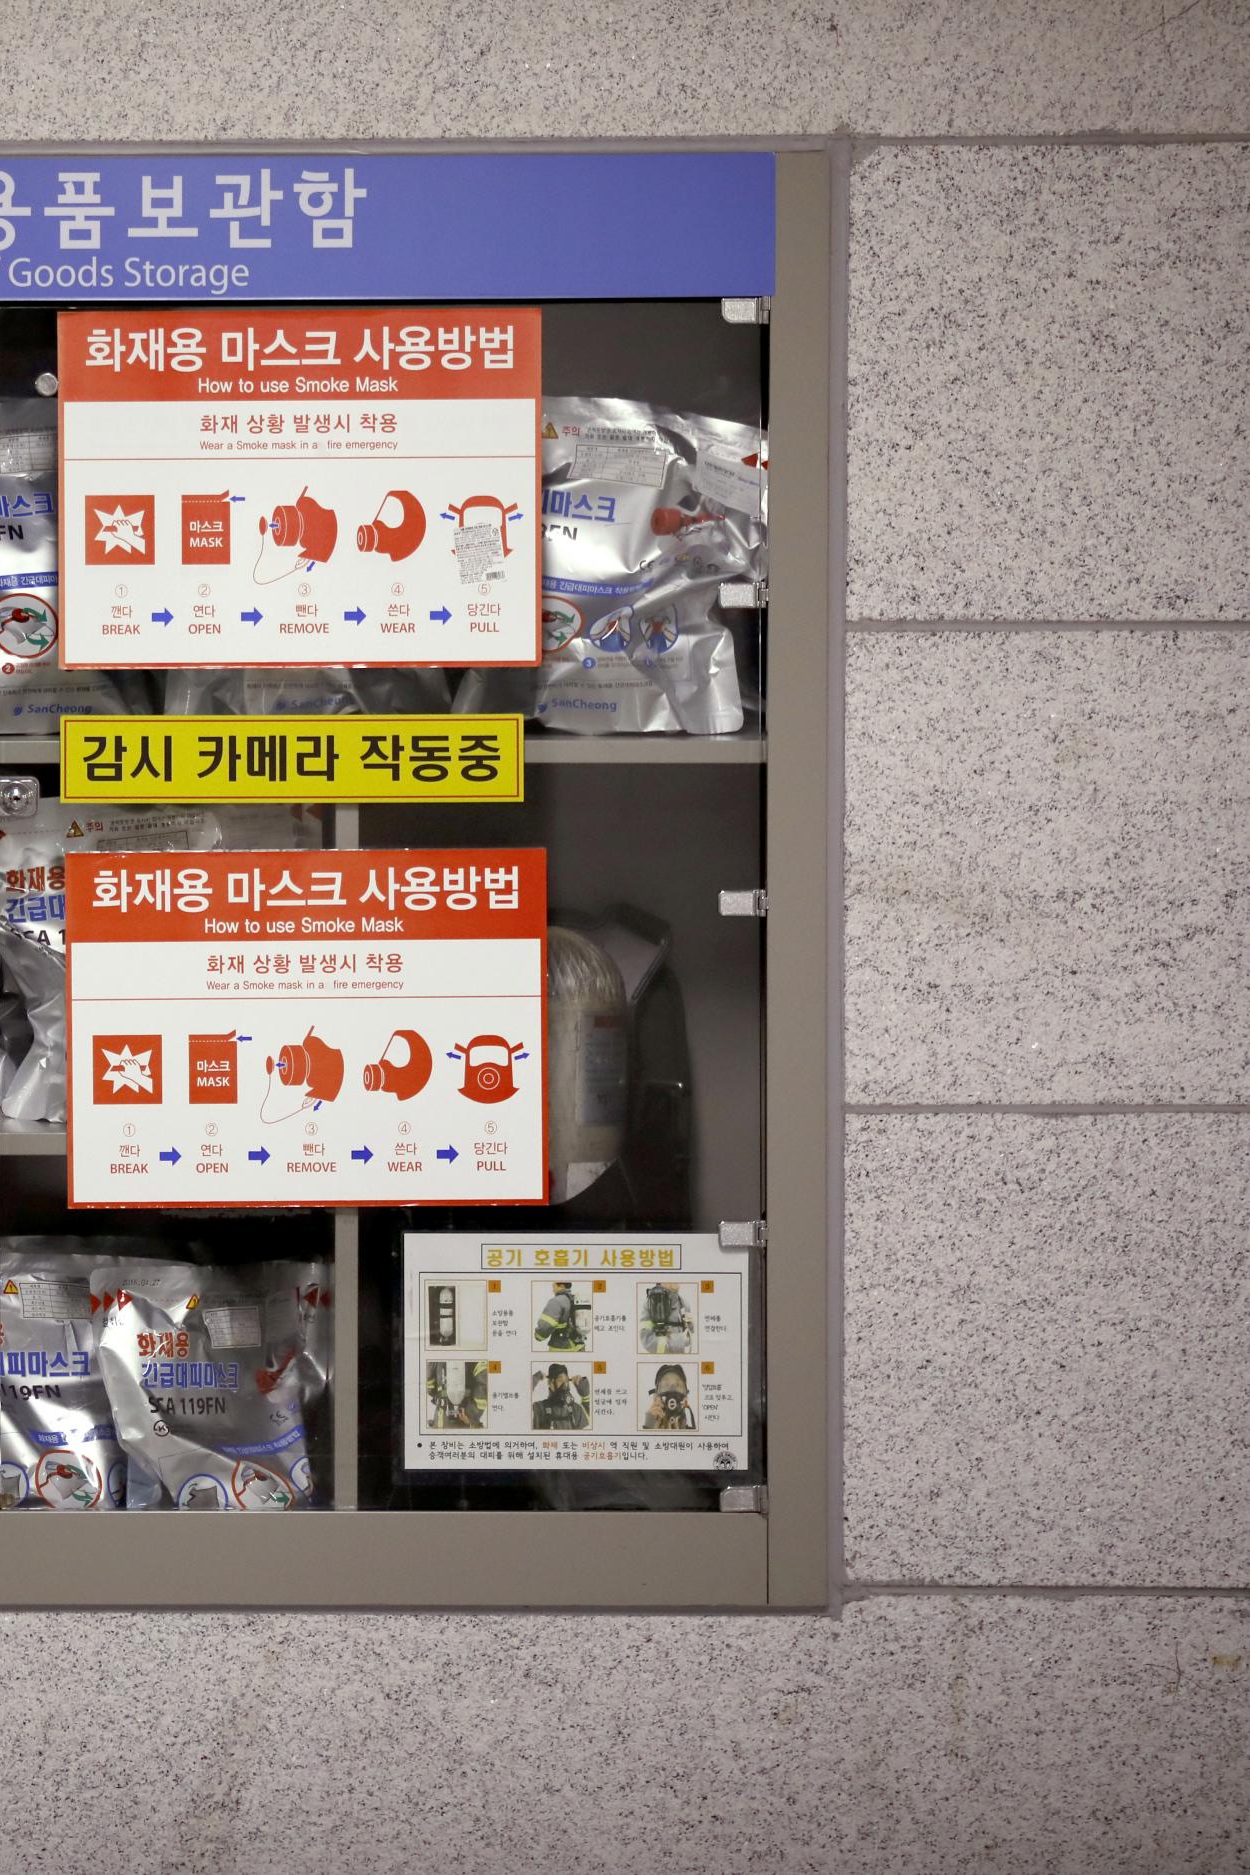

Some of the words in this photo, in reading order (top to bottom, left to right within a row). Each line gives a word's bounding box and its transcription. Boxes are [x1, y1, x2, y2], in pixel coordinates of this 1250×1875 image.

[8, 257, 114, 287] Goods
[124, 257, 250, 294] Storage
[85, 327, 207, 372] 화재용
[222, 327, 342, 371] 마스크
[353, 325, 515, 371] 사용방법
[198, 378, 233, 393] How
[239, 380, 254, 393] to
[260, 382, 289, 393] use
[295, 377, 351, 393] Smoke
[356, 377, 398, 392] Mask
[200, 414, 239, 433] 화재
[246, 414, 285, 433] 상황
[293, 414, 351, 433] 발생시
[359, 413, 398, 433] 착용
[561, 425, 581, 436] 주의
[200, 440, 225, 450] Wear
[236, 440, 269, 450] Smoke
[271, 440, 296, 450] mask
[300, 440, 308, 450] in
[327, 440, 342, 450] fire
[345, 440, 398, 451] emergency
[189, 520, 223, 533] 마스크
[189, 536, 223, 548] MASK
[192, 604, 216, 619] 연다
[387, 603, 410, 617] 쓴다
[467, 602, 501, 617] 당긴다
[102, 623, 141, 635] BREAK
[188, 623, 222, 635] OPEN
[279, 622, 330, 634] REMOVE
[380, 621, 415, 634] WEAR
[470, 621, 500, 633] PULL
[27, 704, 93, 715] SanCheong
[552, 698, 617, 713] SanCheong
[82, 735, 173, 783] 감시
[197, 734, 339, 783] 카메라
[359, 734, 501, 783] 작동중
[86, 821, 104, 833] 주의
[6, 866, 66, 893] 화재용
[92, 868, 213, 912] 화재용
[228, 867, 347, 911] 마스크
[358, 865, 520, 911] 사용방법
[204, 918, 240, 933] How
[245, 920, 262, 933] to
[266, 921, 296, 933] use
[301, 918, 356, 933] Smoke
[361, 917, 404, 932] Mask
[206, 954, 246, 973] 화재
[253, 954, 292, 973] 상황
[299, 954, 358, 973] 발생시
[365, 953, 404, 973] 착용
[206, 980, 231, 990] Wear
[242, 980, 275, 990] Smoke
[277, 980, 303, 990] mask
[306, 980, 315, 990] in
[333, 980, 348, 990] fire
[351, 980, 404, 991] emergency
[196, 1059, 231, 1072] 마스크
[196, 1076, 230, 1088] MASK
[200, 1143, 223, 1158] 연다
[394, 1142, 417, 1156] 쓴다
[474, 1141, 508, 1156] 당긴다
[110, 1162, 149, 1174] BREAK
[196, 1162, 229, 1174] OPEN
[286, 1161, 337, 1173] REMOVE
[387, 1160, 422, 1173] WEAR
[476, 1160, 507, 1172] PULL
[487, 1248, 522, 1268] 공기
[534, 1248, 588, 1268] 호흡기
[600, 1248, 675, 1268] 사용방법
[137, 1330, 190, 1359] 화재용
[140, 1361, 240, 1390] 긴급대피마스크
[181, 1396, 226, 1415] 119FN
[441, 1441, 464, 1450] 장비는
[563, 1441, 579, 1450] 또는
[582, 1441, 605, 1450] 비상시
[622, 1441, 638, 1450] 직원
